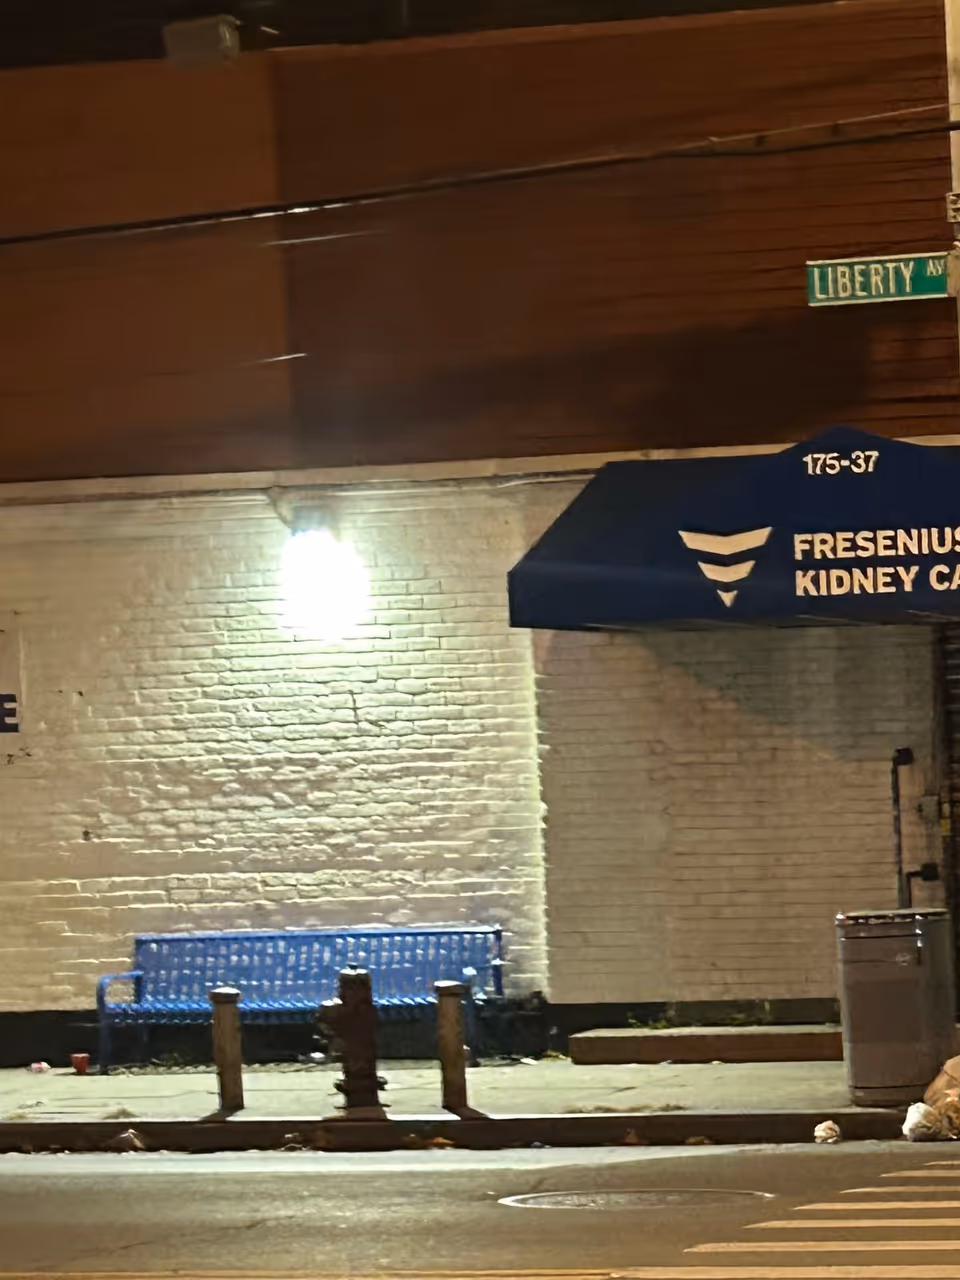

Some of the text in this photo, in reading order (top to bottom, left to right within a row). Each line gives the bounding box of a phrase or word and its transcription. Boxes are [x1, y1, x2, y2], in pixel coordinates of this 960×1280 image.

[813, 259, 946, 299] LIBERTY AV
[802, 450, 880, 475] 175-37
[795, 564, 919, 596] KIDNEY
